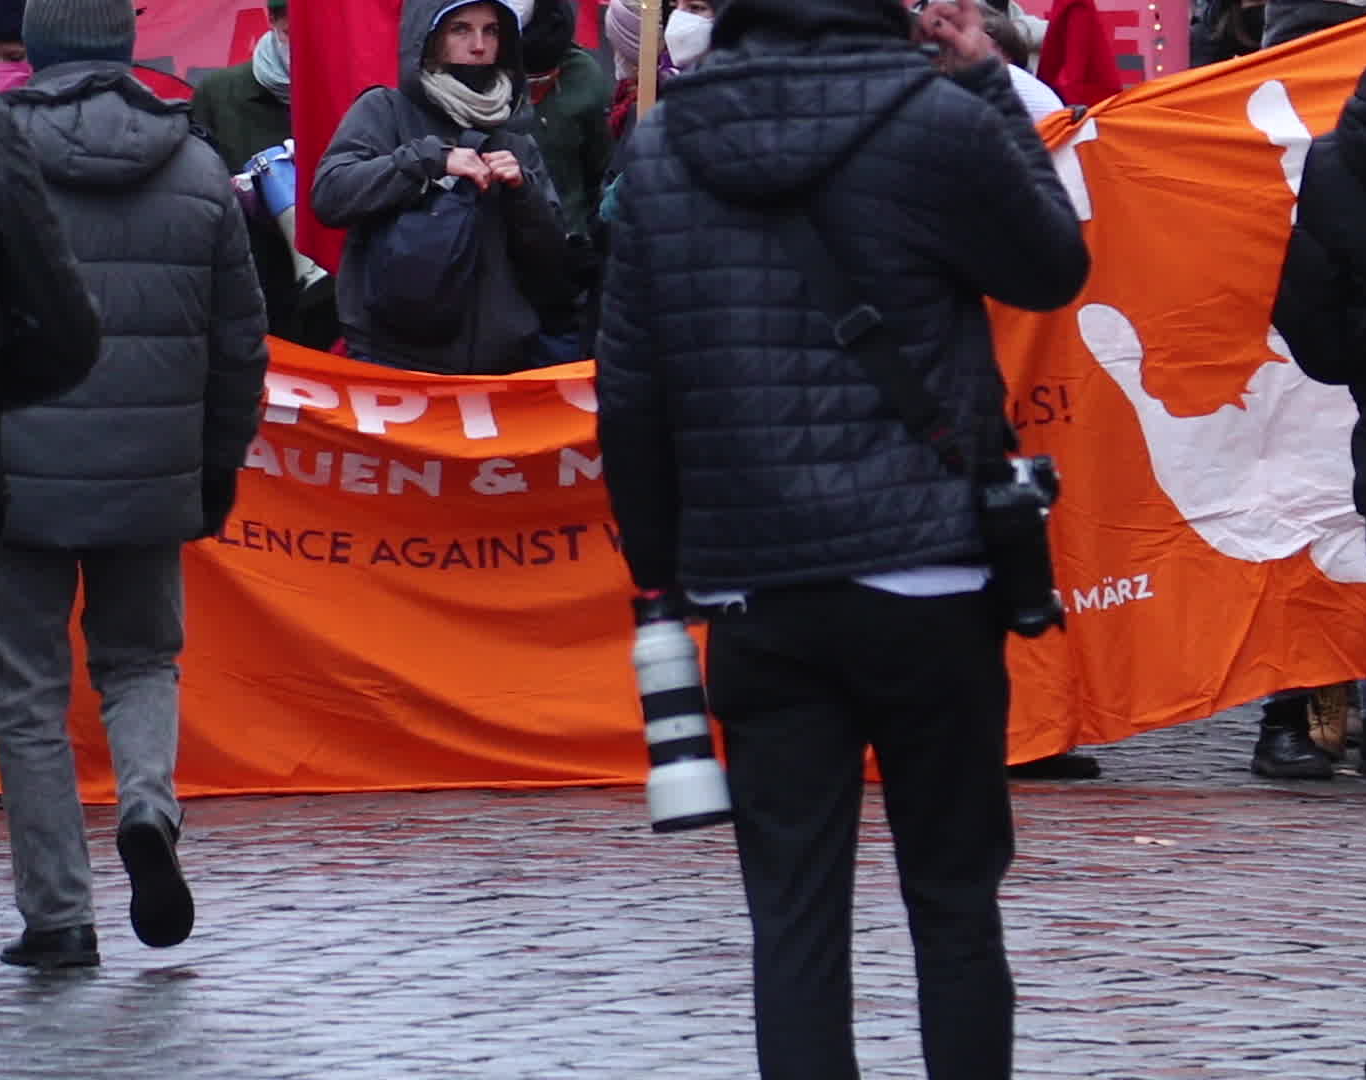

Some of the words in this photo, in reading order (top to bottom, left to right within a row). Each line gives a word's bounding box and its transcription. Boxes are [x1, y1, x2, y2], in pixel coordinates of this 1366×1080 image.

[470, 456, 529, 496] &
[370, 524, 589, 570] AGAINST
[1075, 573, 1155, 614] MÄRZ
